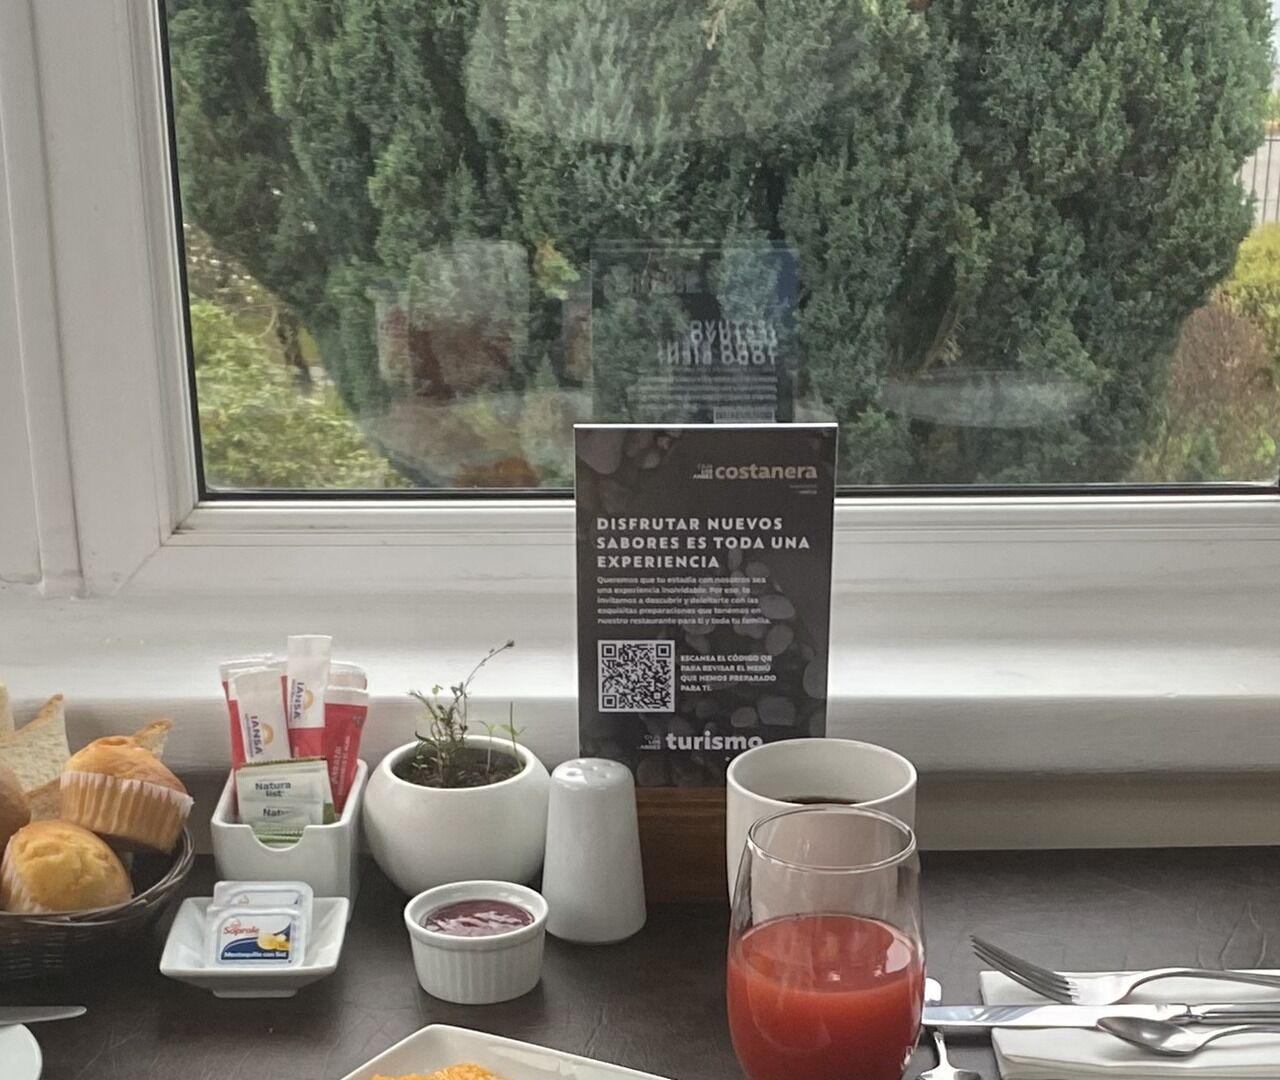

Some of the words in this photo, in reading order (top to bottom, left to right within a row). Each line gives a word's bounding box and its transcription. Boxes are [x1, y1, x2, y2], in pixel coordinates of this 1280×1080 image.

[715, 463, 817, 479] costanera
[596, 517, 700, 530] DISFRUTAR
[707, 517, 783, 530] NUEVOS
[596, 537, 679, 549] SABORES
[687, 537, 707, 549] ES
[713, 537, 765, 549] TODA
[771, 537, 810, 549] UNA
[597, 556, 720, 568] EXPERIENCIA
[596, 586, 613, 595] una
[614, 586, 660, 595] experiencia
[742, 586, 751, 595] te
[596, 596, 637, 605] invitamos
[638, 596, 644, 605] a
[645, 596, 682, 605] descubrir
[683, 596, 689, 605] y
[690, 596, 729, 605] deleitarte
[730, 596, 746, 605] con
[747, 596, 759, 605] las
[596, 606, 638, 616] exquisitas
[639, 606, 696, 616] preparaciones
[697, 606, 712, 616] que
[714, 606, 749, 616] tenemos
[750, 606, 761, 616] en
[597, 617, 628, 625] nuestro
[630, 617, 676, 625] restaurante
[678, 617, 696, 625] para
[698, 617, 704, 625] ti
[704, 617, 711, 625] y
[711, 617, 730, 625] toda
[731, 617, 740, 625] tu
[717, 654, 726, 663] EL
[727, 654, 759, 663] CÓDIGO
[760, 654, 773, 663] QR
[680, 664, 701, 672] PARA
[702, 664, 735, 672] REVISAR
[736, 664, 745, 672] EL
[680, 674, 697, 683] QUE
[699, 674, 727, 683] HEMOS
[728, 674, 777, 683] PREPARADO
[680, 684, 701, 692] PARA
[293, 681, 305, 720] IANSA
[251, 714, 264, 756] IANSA
[665, 730, 763, 750] turismo
[255, 782, 291, 790] Natura
